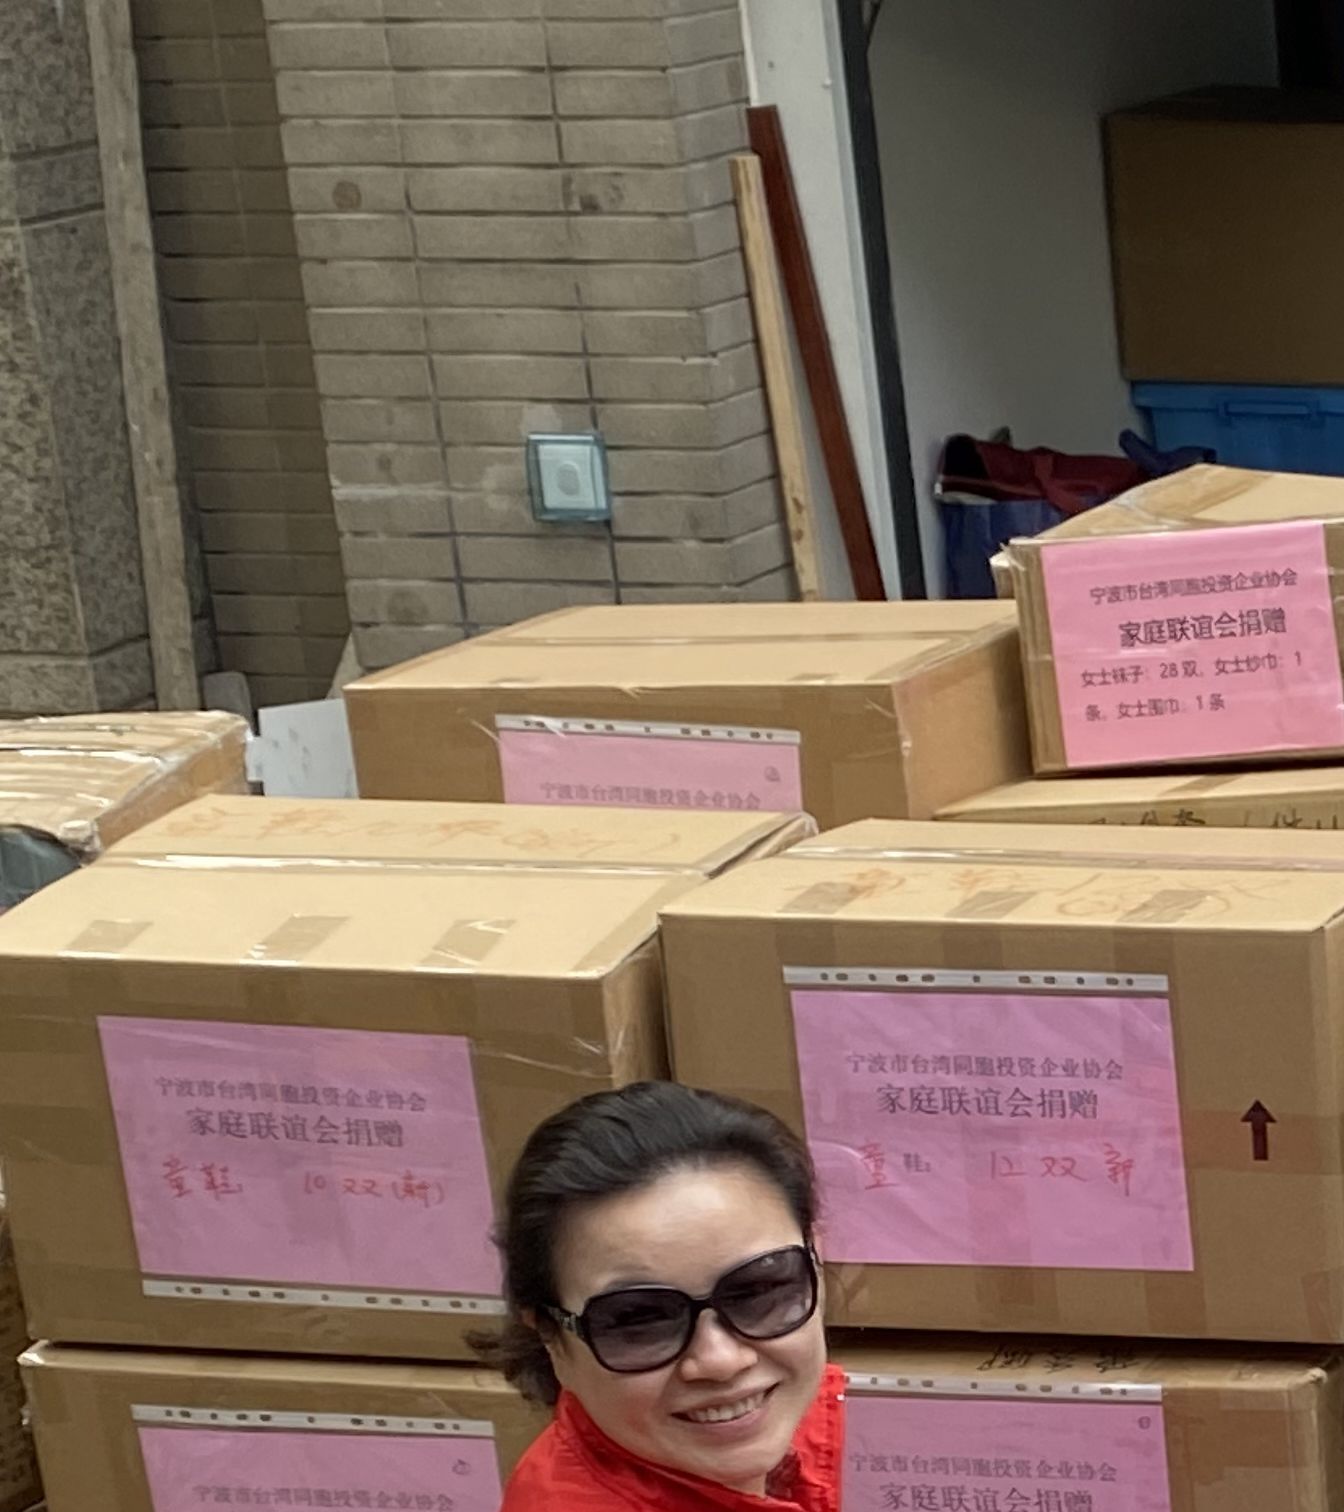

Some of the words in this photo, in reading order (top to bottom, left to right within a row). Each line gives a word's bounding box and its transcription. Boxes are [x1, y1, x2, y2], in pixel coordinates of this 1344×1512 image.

[1089, 567, 1297, 605] 宁波市台湾同胞投资企业协会
[1119, 608, 1286, 647] 家庭联谊会捐赠
[846, 1052, 1124, 1082] 宁波市台湾同胞投资企业协会
[157, 1077, 426, 1112] 宁波市台湾同胞投资企业协会
[876, 1083, 1099, 1120] 家庭联谊会捐赠
[186, 1107, 404, 1147] 家庭联谊会捐赠
[850, 1453, 1117, 1482] 宁波市台湾同胞投资企业协会
